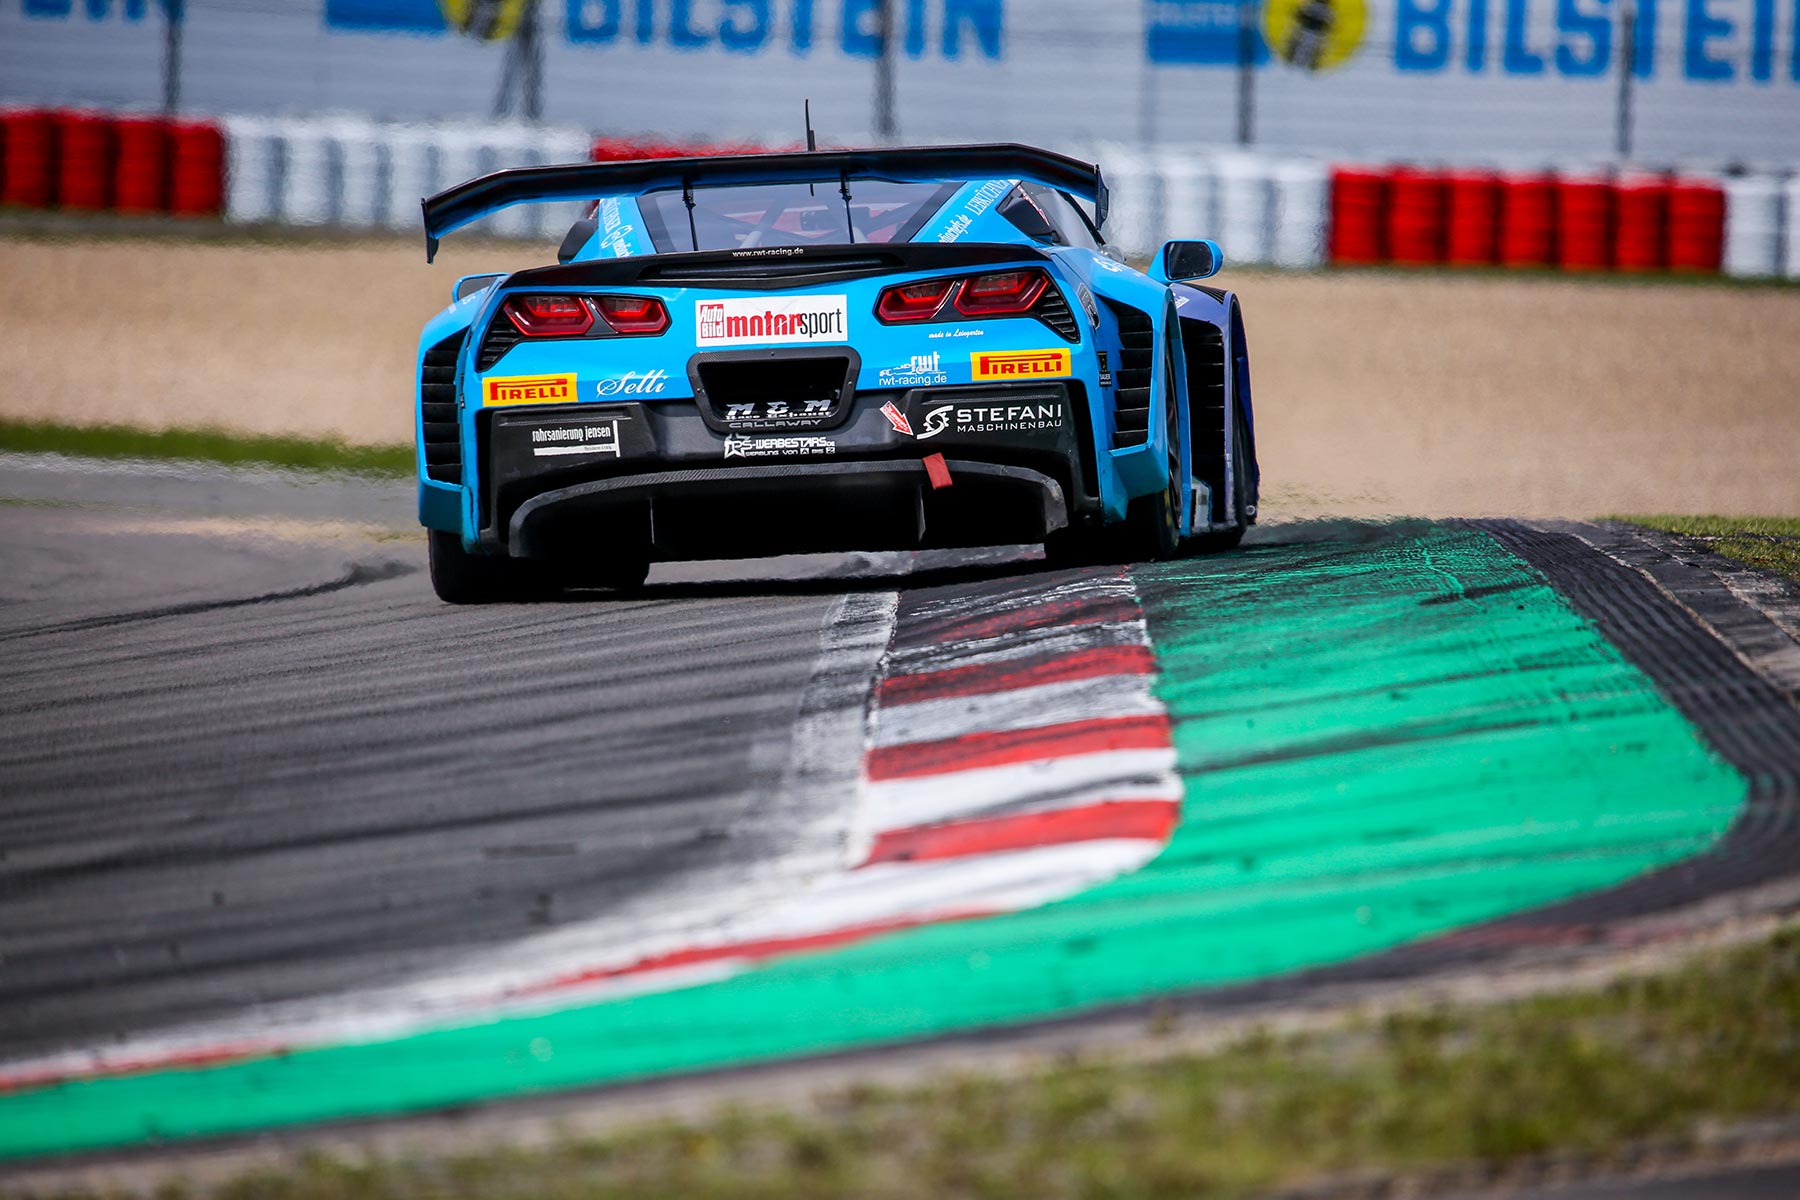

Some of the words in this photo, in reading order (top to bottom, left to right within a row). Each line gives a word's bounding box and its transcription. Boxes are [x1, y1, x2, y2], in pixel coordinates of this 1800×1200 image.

[1393, 0, 1800, 81] BILSTEI
[732, 247, 804, 257] www.rwt-racing.de
[701, 305, 723, 322] Auto
[702, 322, 724, 337] Bild
[980, 353, 1063, 375] PIRELLI
[879, 374, 947, 386] rwt-racing.de
[490, 378, 568, 401] PIRELLI
[726, 403, 755, 416] M
[804, 400, 831, 412] M
[957, 404, 1062, 423] STEFANI
[729, 419, 822, 429] CALLAWAY
[957, 420, 1062, 433] MASCHINENBAU
[532, 428, 584, 442] rohrsanierung
[585, 426, 611, 441] jensen
